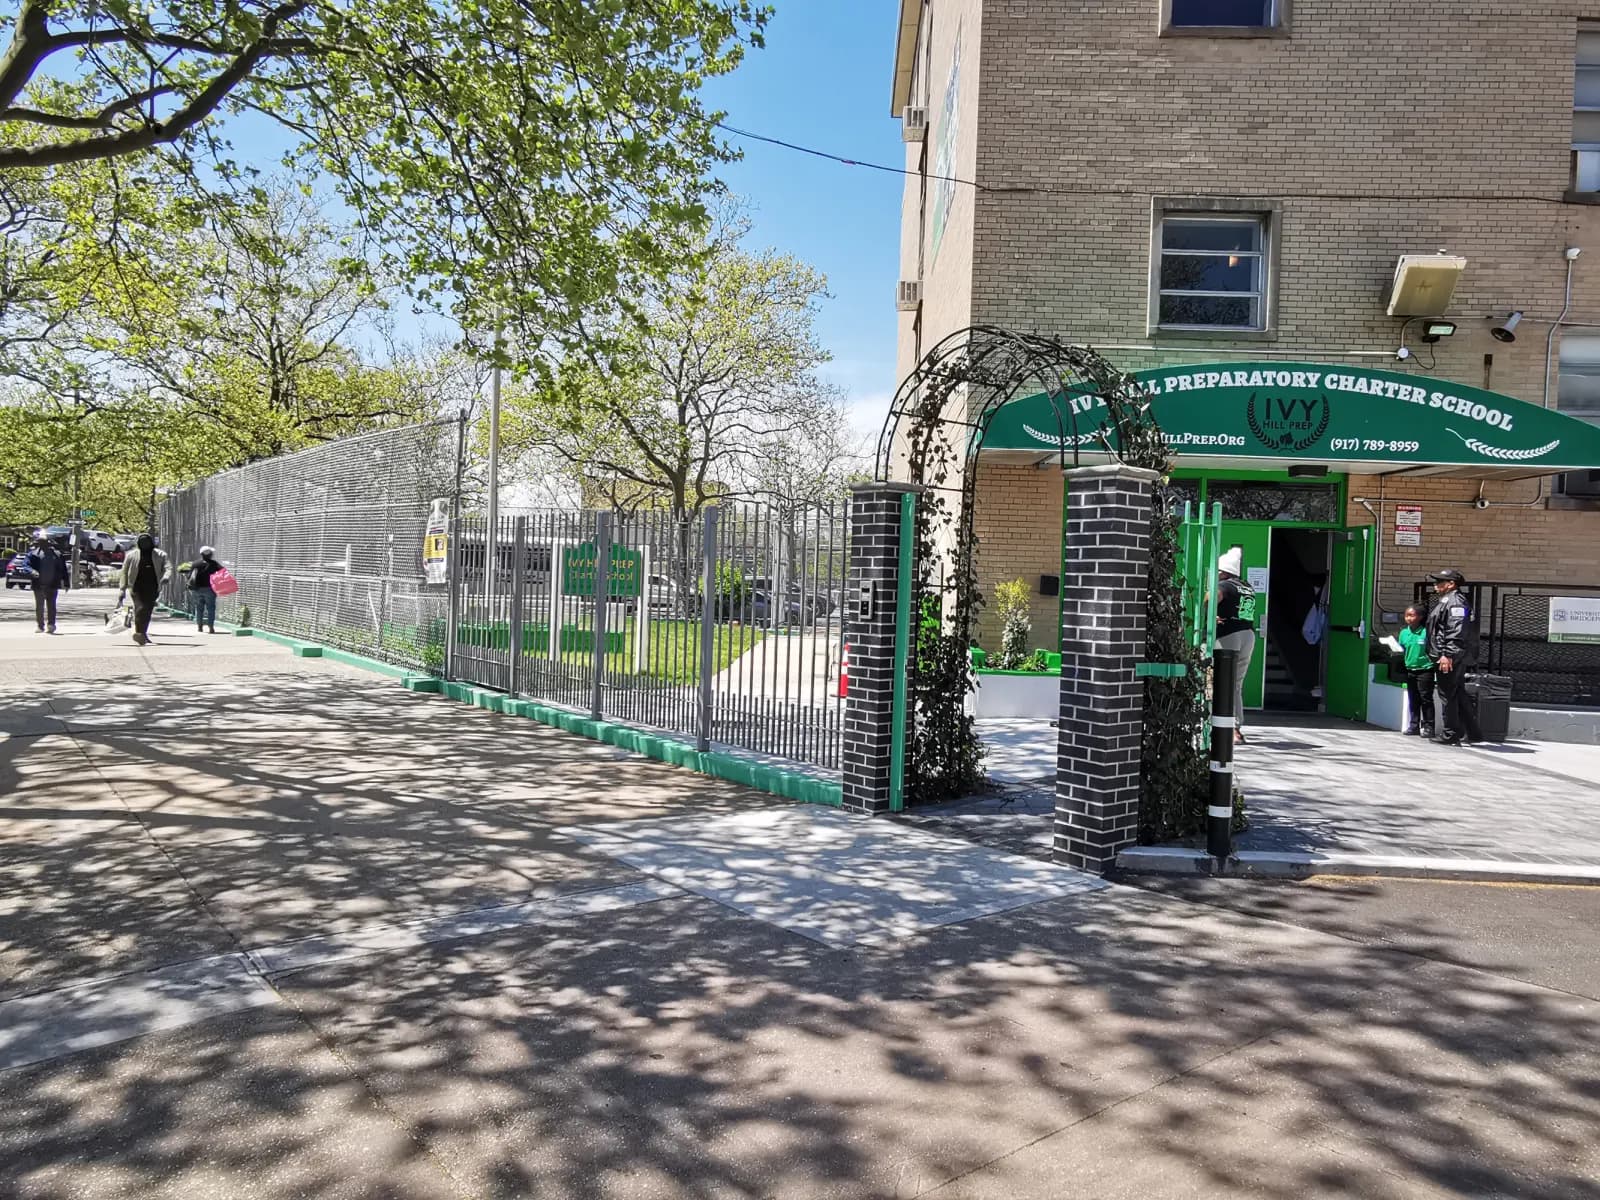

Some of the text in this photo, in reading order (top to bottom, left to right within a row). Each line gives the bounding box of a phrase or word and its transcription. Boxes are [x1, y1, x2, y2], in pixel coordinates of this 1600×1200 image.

[1163, 371, 1321, 392] PREPARATORY
[1324, 374, 1427, 404] CHARTER
[1428, 392, 1514, 431] SCHOOL
[1265, 398, 1319, 421] IVY
[1263, 420, 1313, 430] HILL PREP
[1330, 437, 1420, 452] (917) 789-8959
